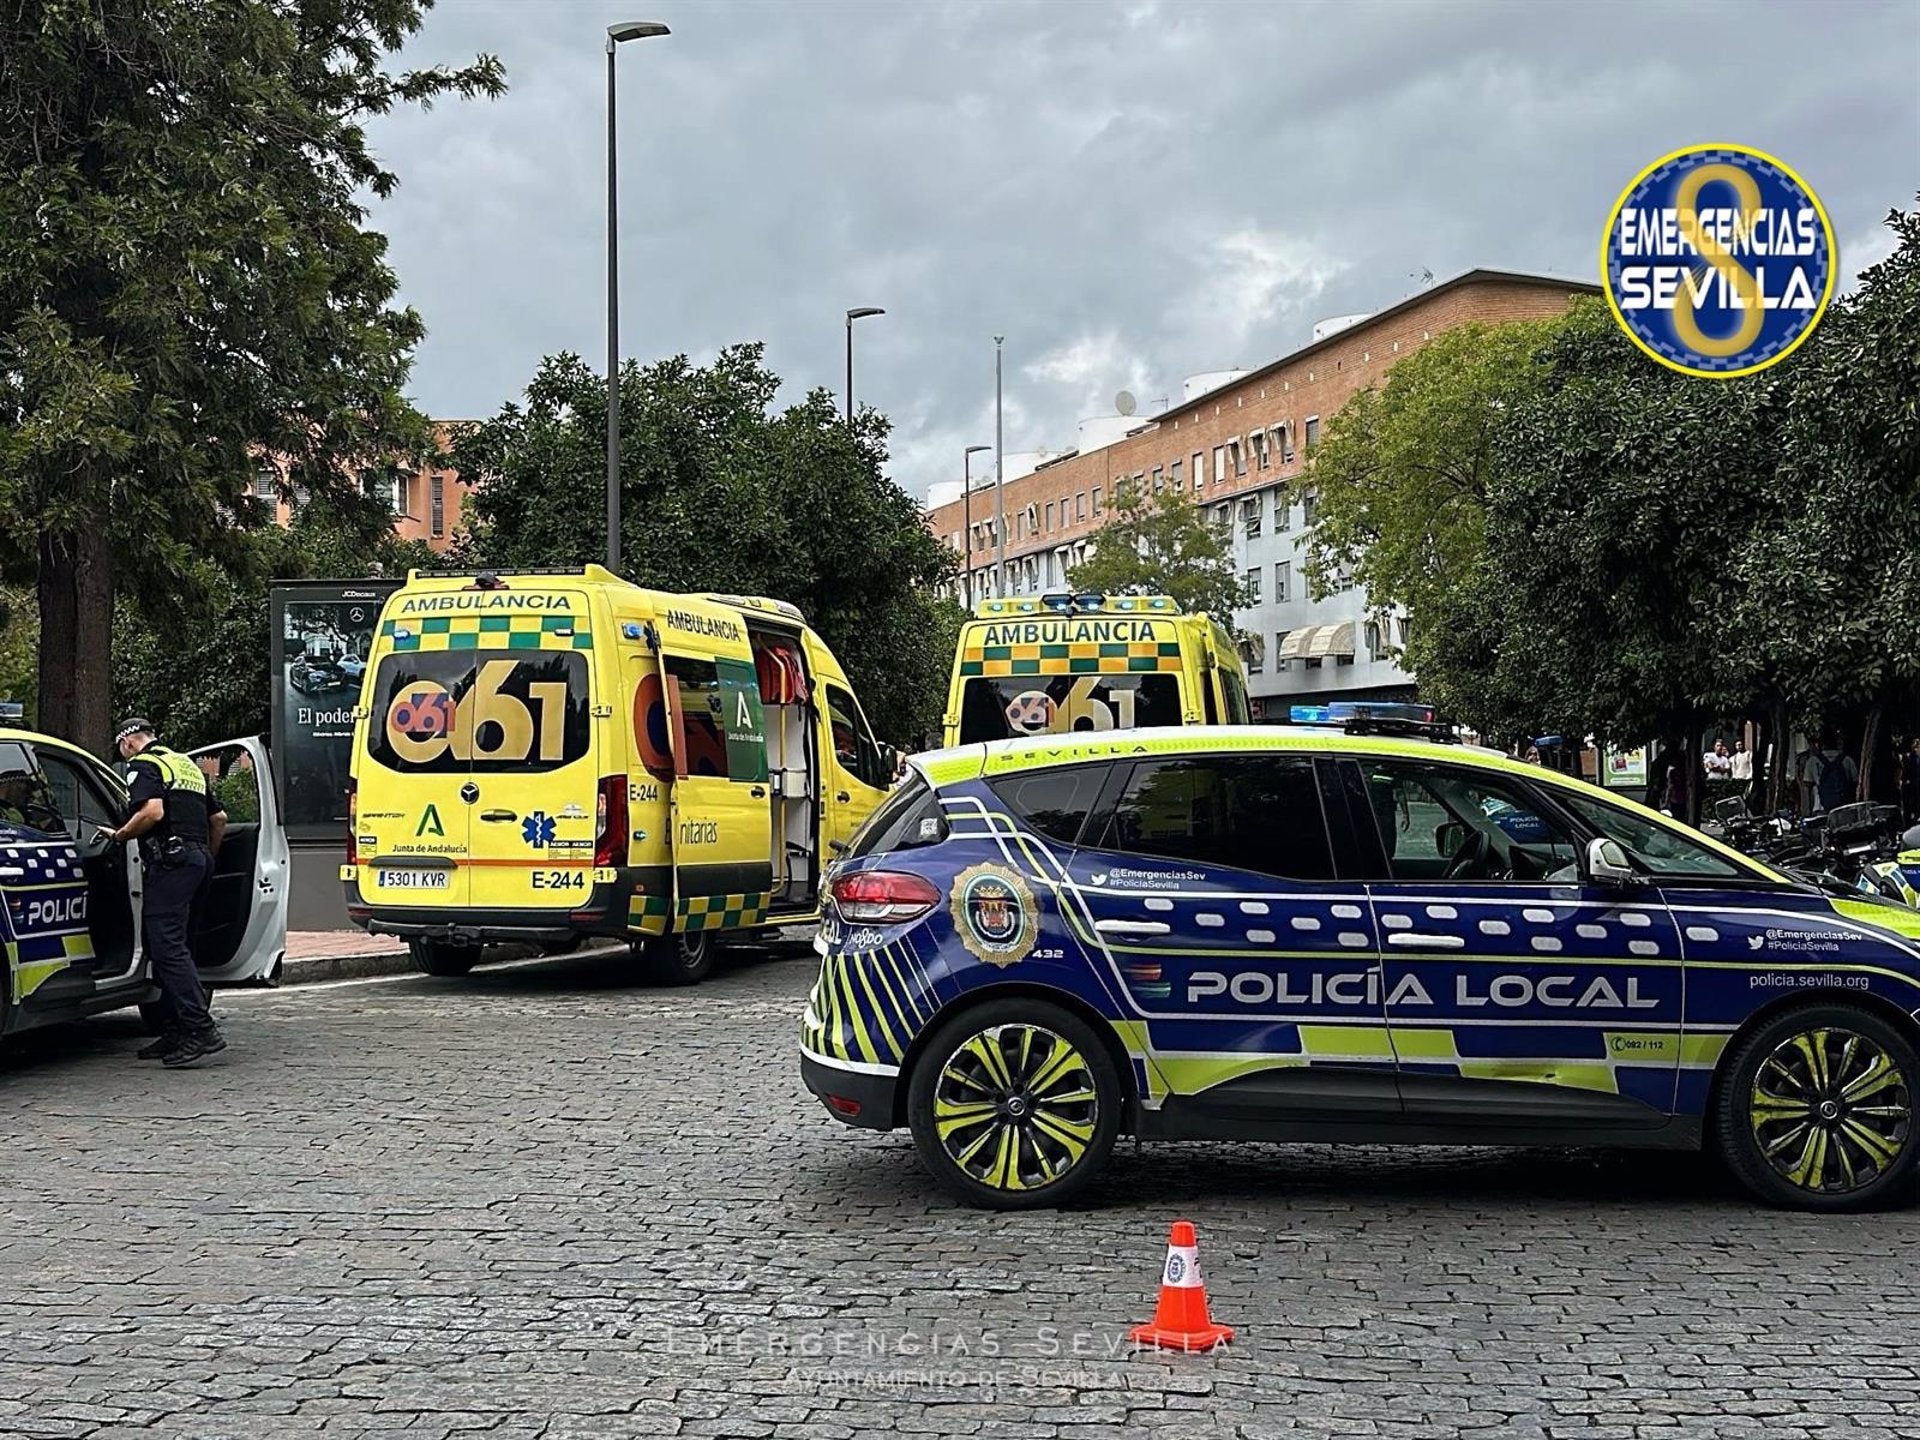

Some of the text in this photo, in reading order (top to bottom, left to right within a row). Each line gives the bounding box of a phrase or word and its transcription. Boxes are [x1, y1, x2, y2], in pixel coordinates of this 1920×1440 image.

[401, 595, 571, 613] AMBULANCIA
[667, 609, 741, 642] AMBULANCIA
[984, 621, 1156, 646] AMBULANCIA
[298, 708, 312, 724] El
[1000, 746, 1148, 761] SEVILLA
[629, 784, 658, 801] E-244
[392, 843, 467, 853] Junta de Andalucía
[388, 872, 446, 886] 5301 KVR
[532, 871, 585, 889] E-244
[1109, 868, 1206, 880] @EmergenciasSev
[1766, 929, 1862, 941] @EmergenciasSev
[1032, 949, 1064, 959] 432
[1187, 966, 1660, 1008] POLICÍA LOCAL
[1749, 973, 1869, 990] policia.sevilla.org
[1648, 1040, 1663, 1050] 112
